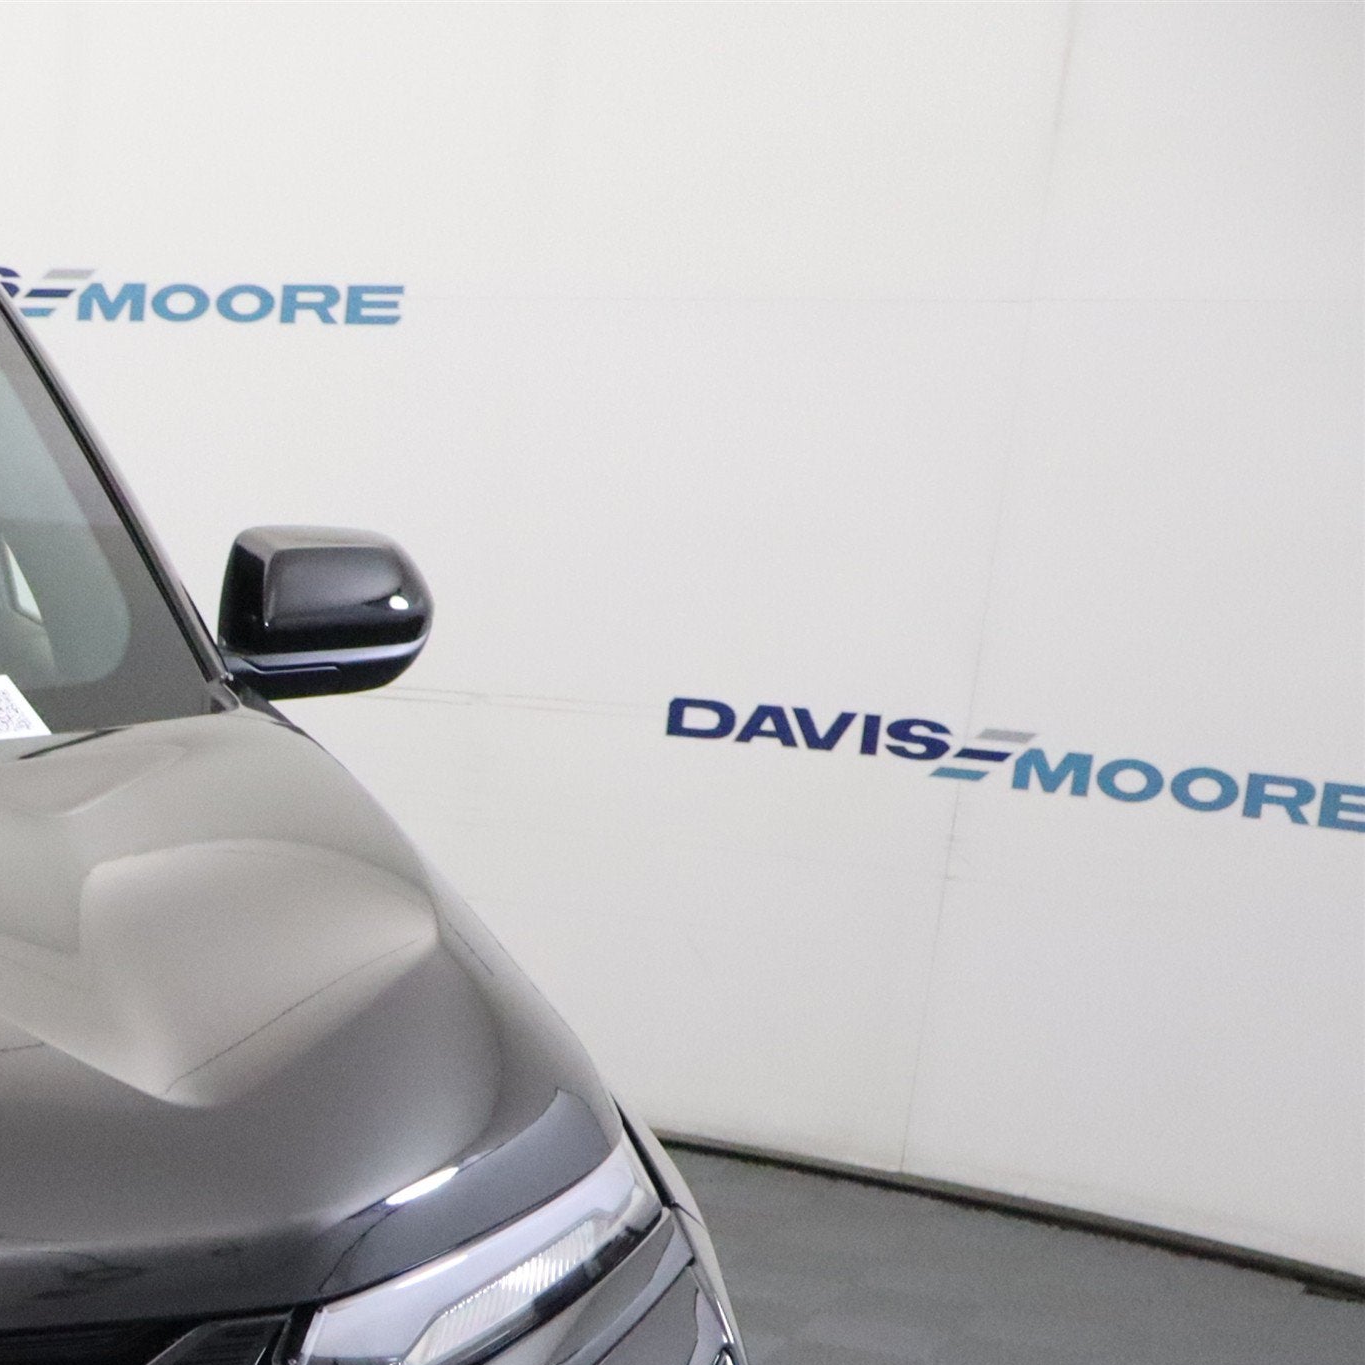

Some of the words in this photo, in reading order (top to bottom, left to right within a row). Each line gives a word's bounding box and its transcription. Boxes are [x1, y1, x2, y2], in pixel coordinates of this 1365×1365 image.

[76, 281, 405, 326] MOORE
[666, 696, 952, 761] DAVIS
[1011, 747, 1365, 833] MOORE
